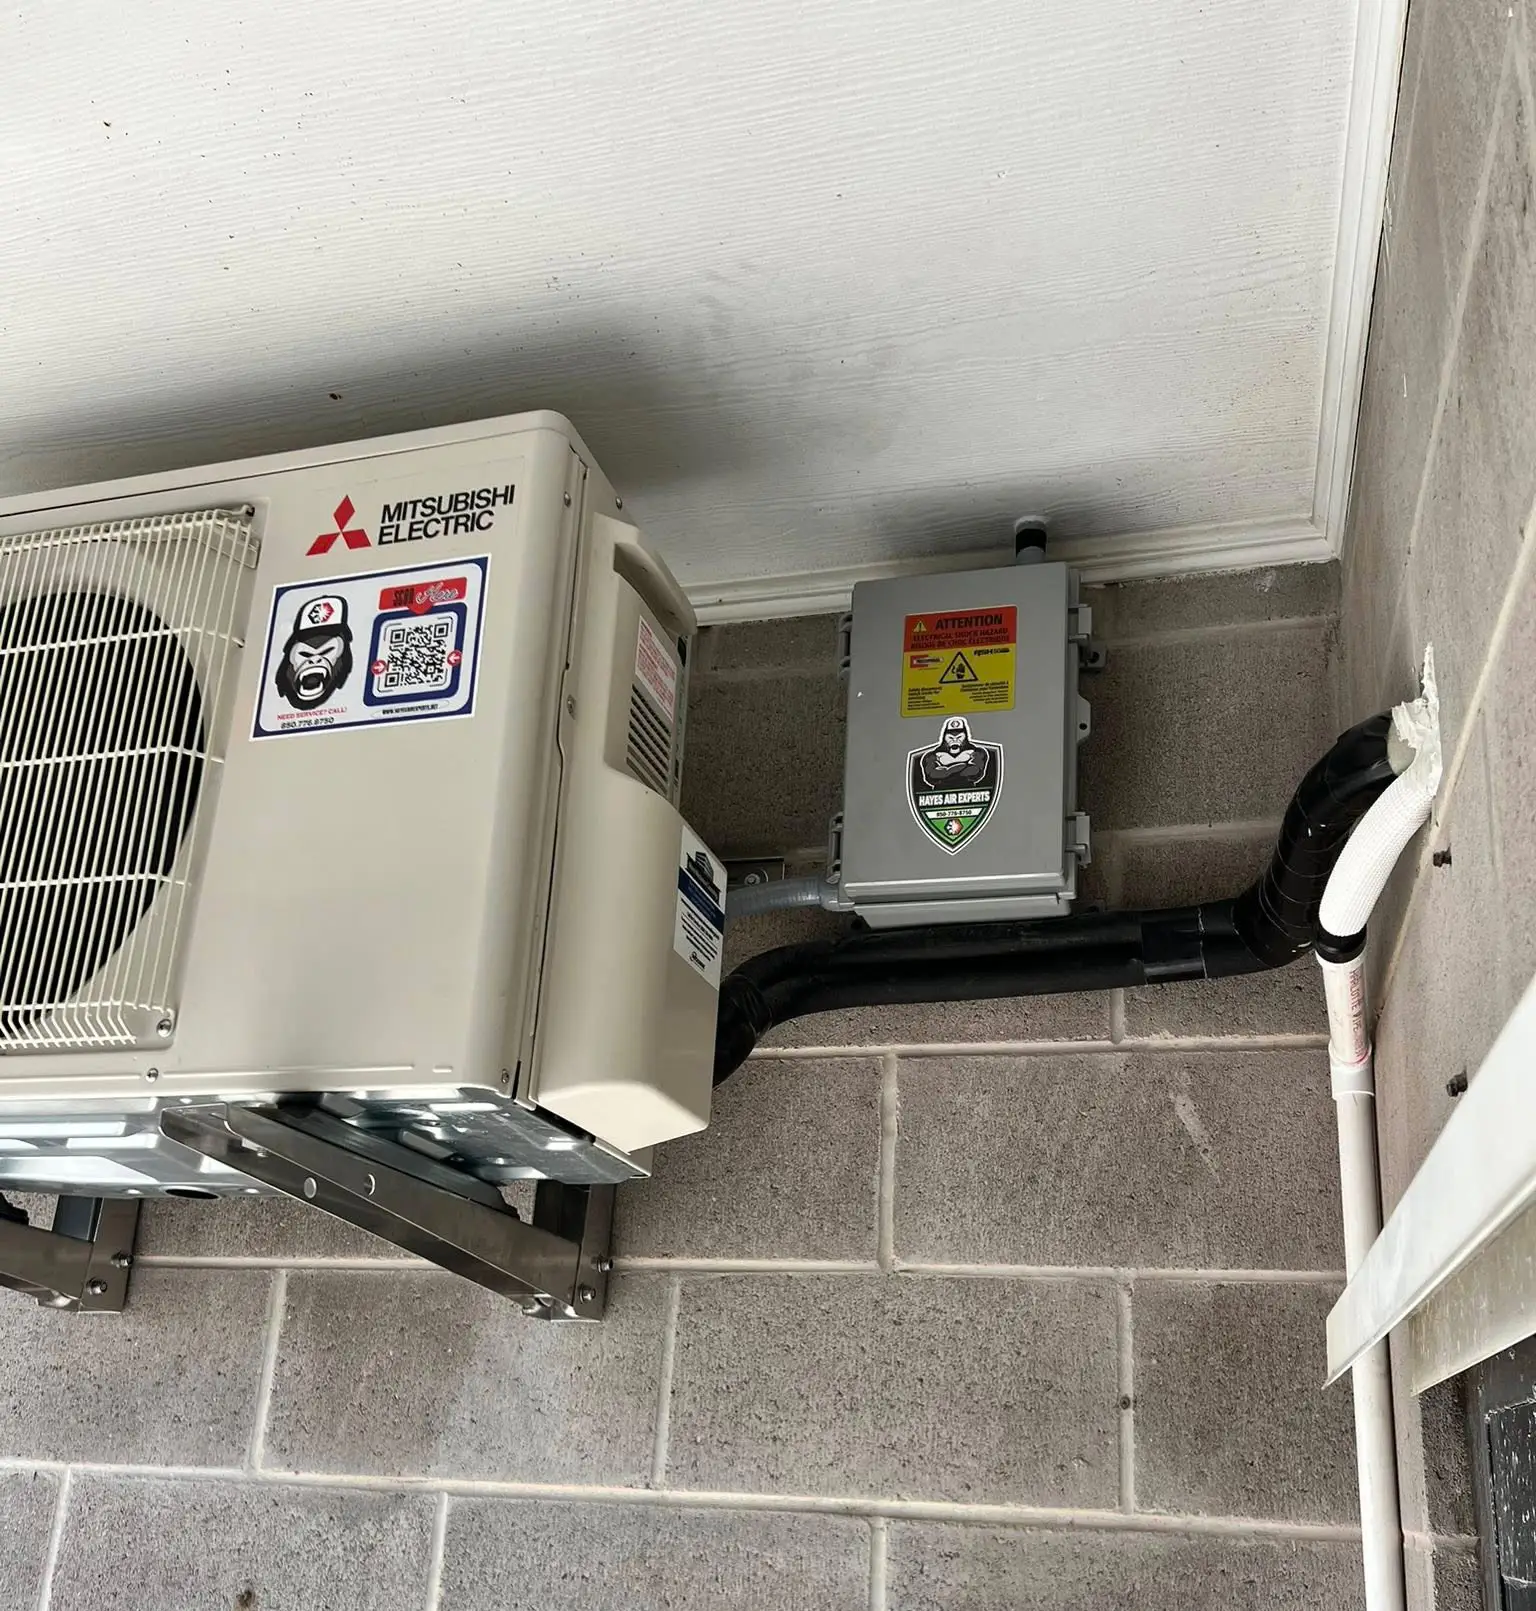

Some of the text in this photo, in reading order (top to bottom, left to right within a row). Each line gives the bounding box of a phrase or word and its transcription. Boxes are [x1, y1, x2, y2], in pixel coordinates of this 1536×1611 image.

[381, 484, 515, 524] MITSUBISHI
[378, 510, 495, 546] ELECTRIC
[935, 614, 1003, 630] ATTENTION
[296, 709, 328, 719] SERVICE?
[919, 791, 990, 806] HAYES AIR EXPERTS
